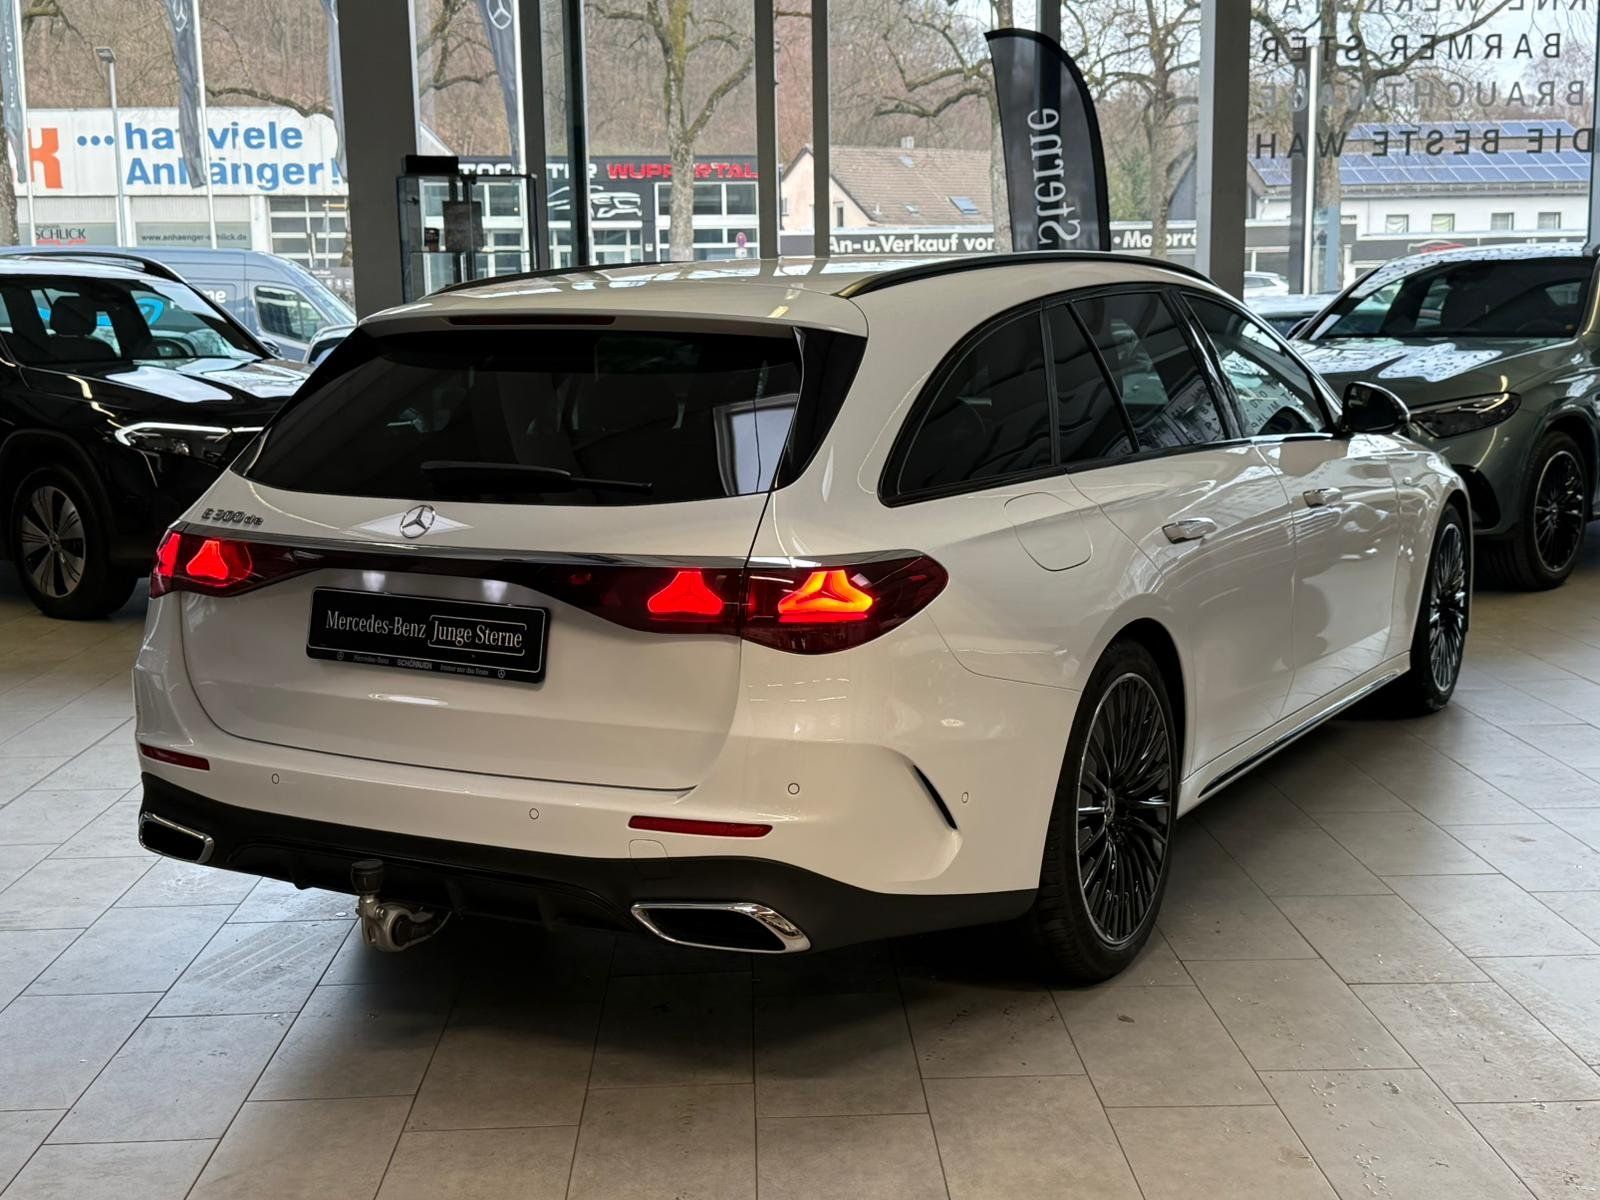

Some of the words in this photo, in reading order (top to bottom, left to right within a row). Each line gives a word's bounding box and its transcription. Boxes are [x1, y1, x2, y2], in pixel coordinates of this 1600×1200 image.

[207, 121, 303, 149] viele
[607, 163, 758, 179] WUPPRTAL
[201, 507, 214, 520] E
[212, 509, 245, 523] 300
[243, 514, 264, 526] de
[325, 610, 427, 638] Mercedes-Benz
[431, 620, 472, 647] Junge
[475, 624, 523, 648] Sterne
